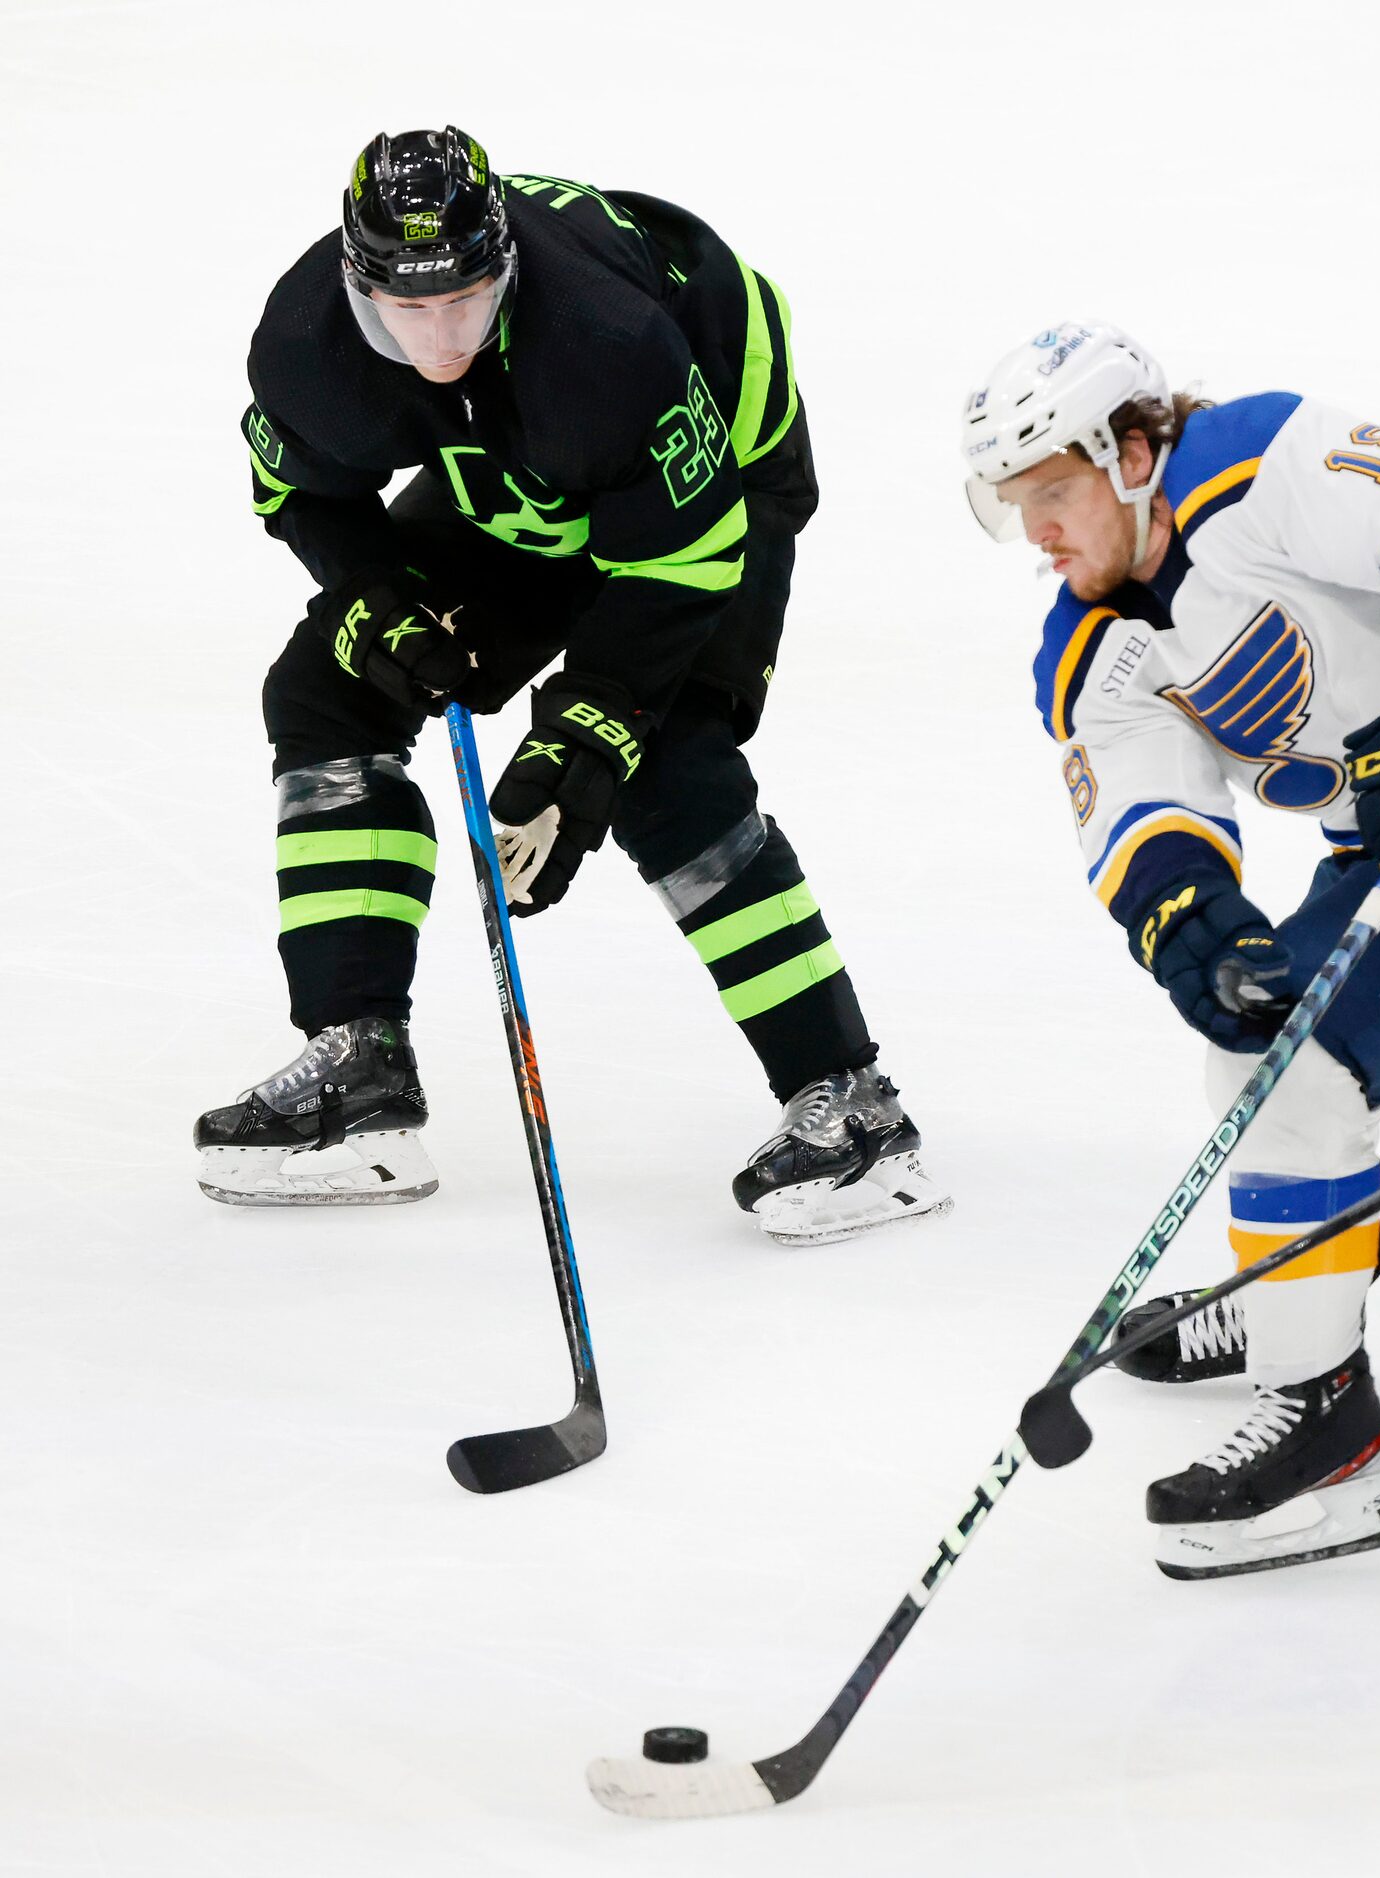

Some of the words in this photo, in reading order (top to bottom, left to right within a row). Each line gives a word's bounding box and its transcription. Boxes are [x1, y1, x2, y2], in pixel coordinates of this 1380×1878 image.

[403, 211, 440, 241] 23
[396, 258, 455, 275] CCM
[650, 363, 730, 510] 23
[968, 436, 998, 456] CCM
[1101, 634, 1152, 699] STIFEL
[1112, 1119, 1242, 1310] JETSPEED
[1179, 1537, 1214, 1552] CCM
